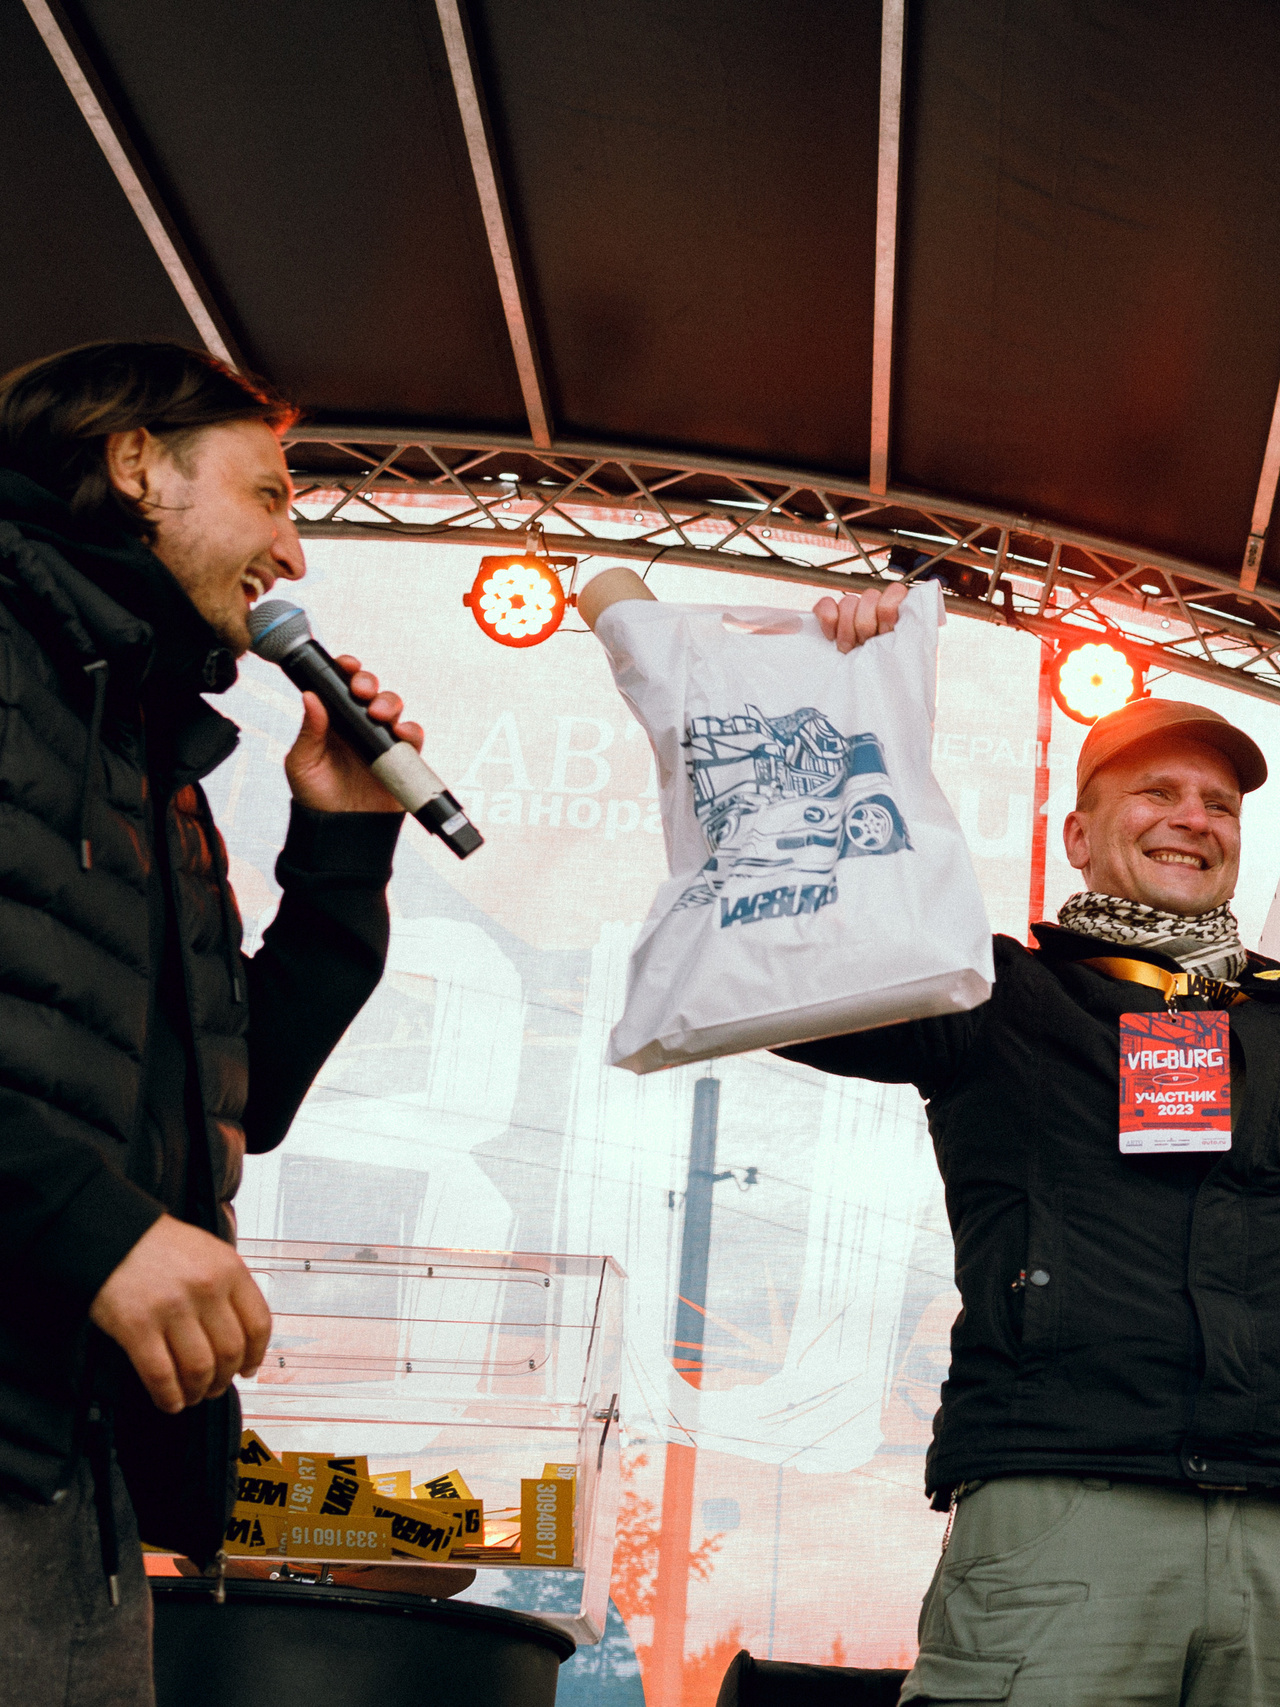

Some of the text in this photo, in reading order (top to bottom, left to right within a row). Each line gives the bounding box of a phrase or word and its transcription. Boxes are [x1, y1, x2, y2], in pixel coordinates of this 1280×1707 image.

[1128, 1048, 1224, 1071] VAGBURG
[1135, 1090, 1217, 1104] УЧАСТНИК
[1157, 1104, 1194, 1116] 2023
[536, 1483, 557, 1560] 30940817
[291, 1526, 378, 1548] 33316015
